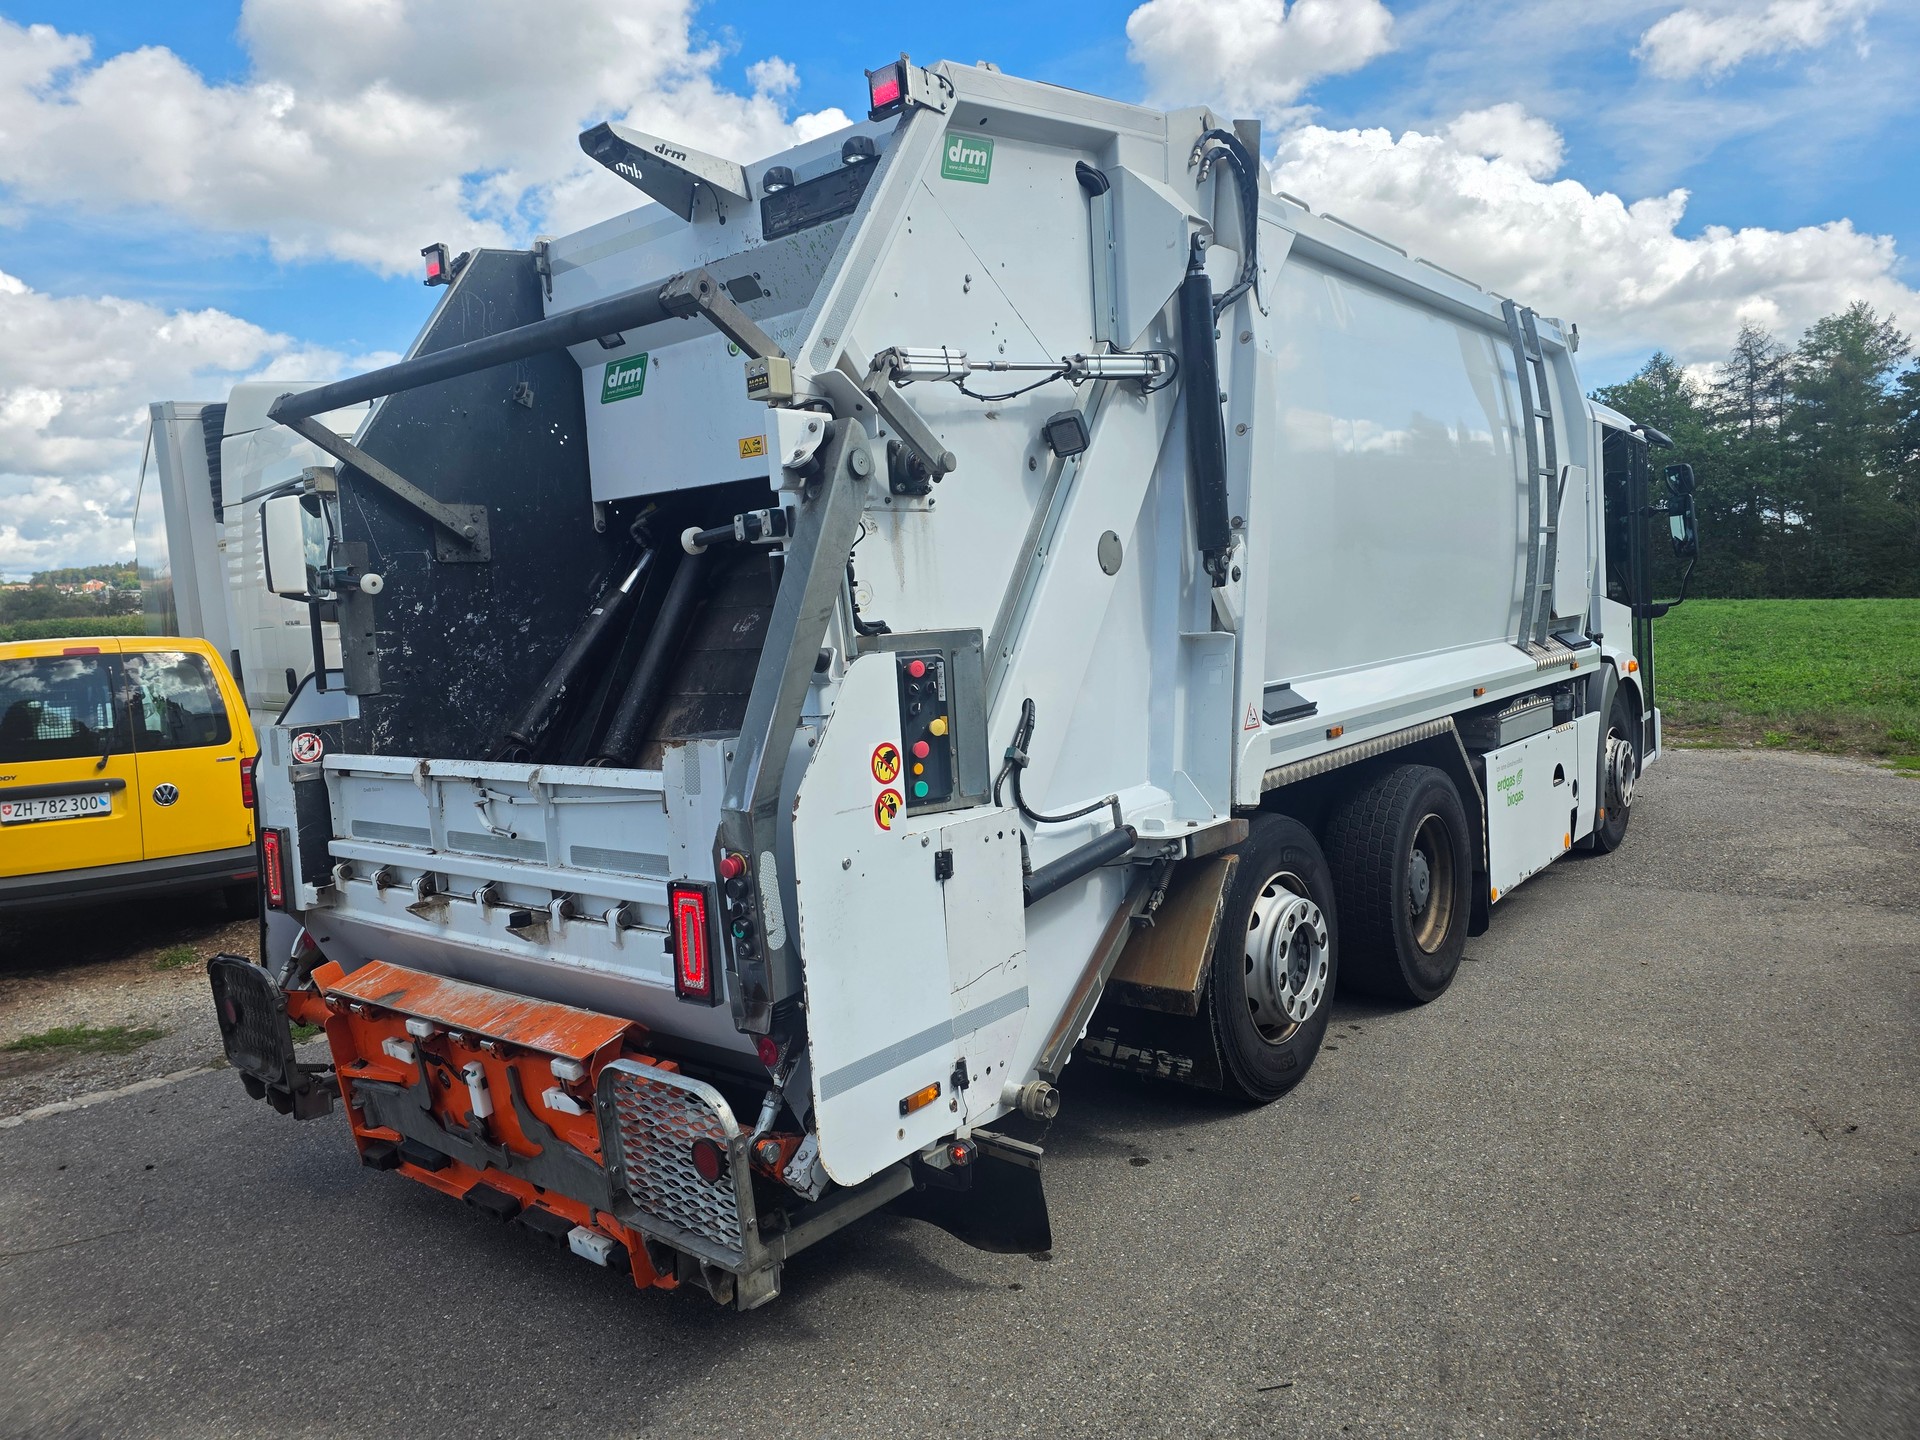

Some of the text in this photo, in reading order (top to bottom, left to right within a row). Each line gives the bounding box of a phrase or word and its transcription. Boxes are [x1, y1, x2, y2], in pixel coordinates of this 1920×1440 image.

[654, 143, 687, 161] drm
[949, 139, 987, 167] drm
[608, 366, 642, 388] drm
[1497, 775, 1516, 792] erdgas
[1506, 790, 1524, 807] biogas
